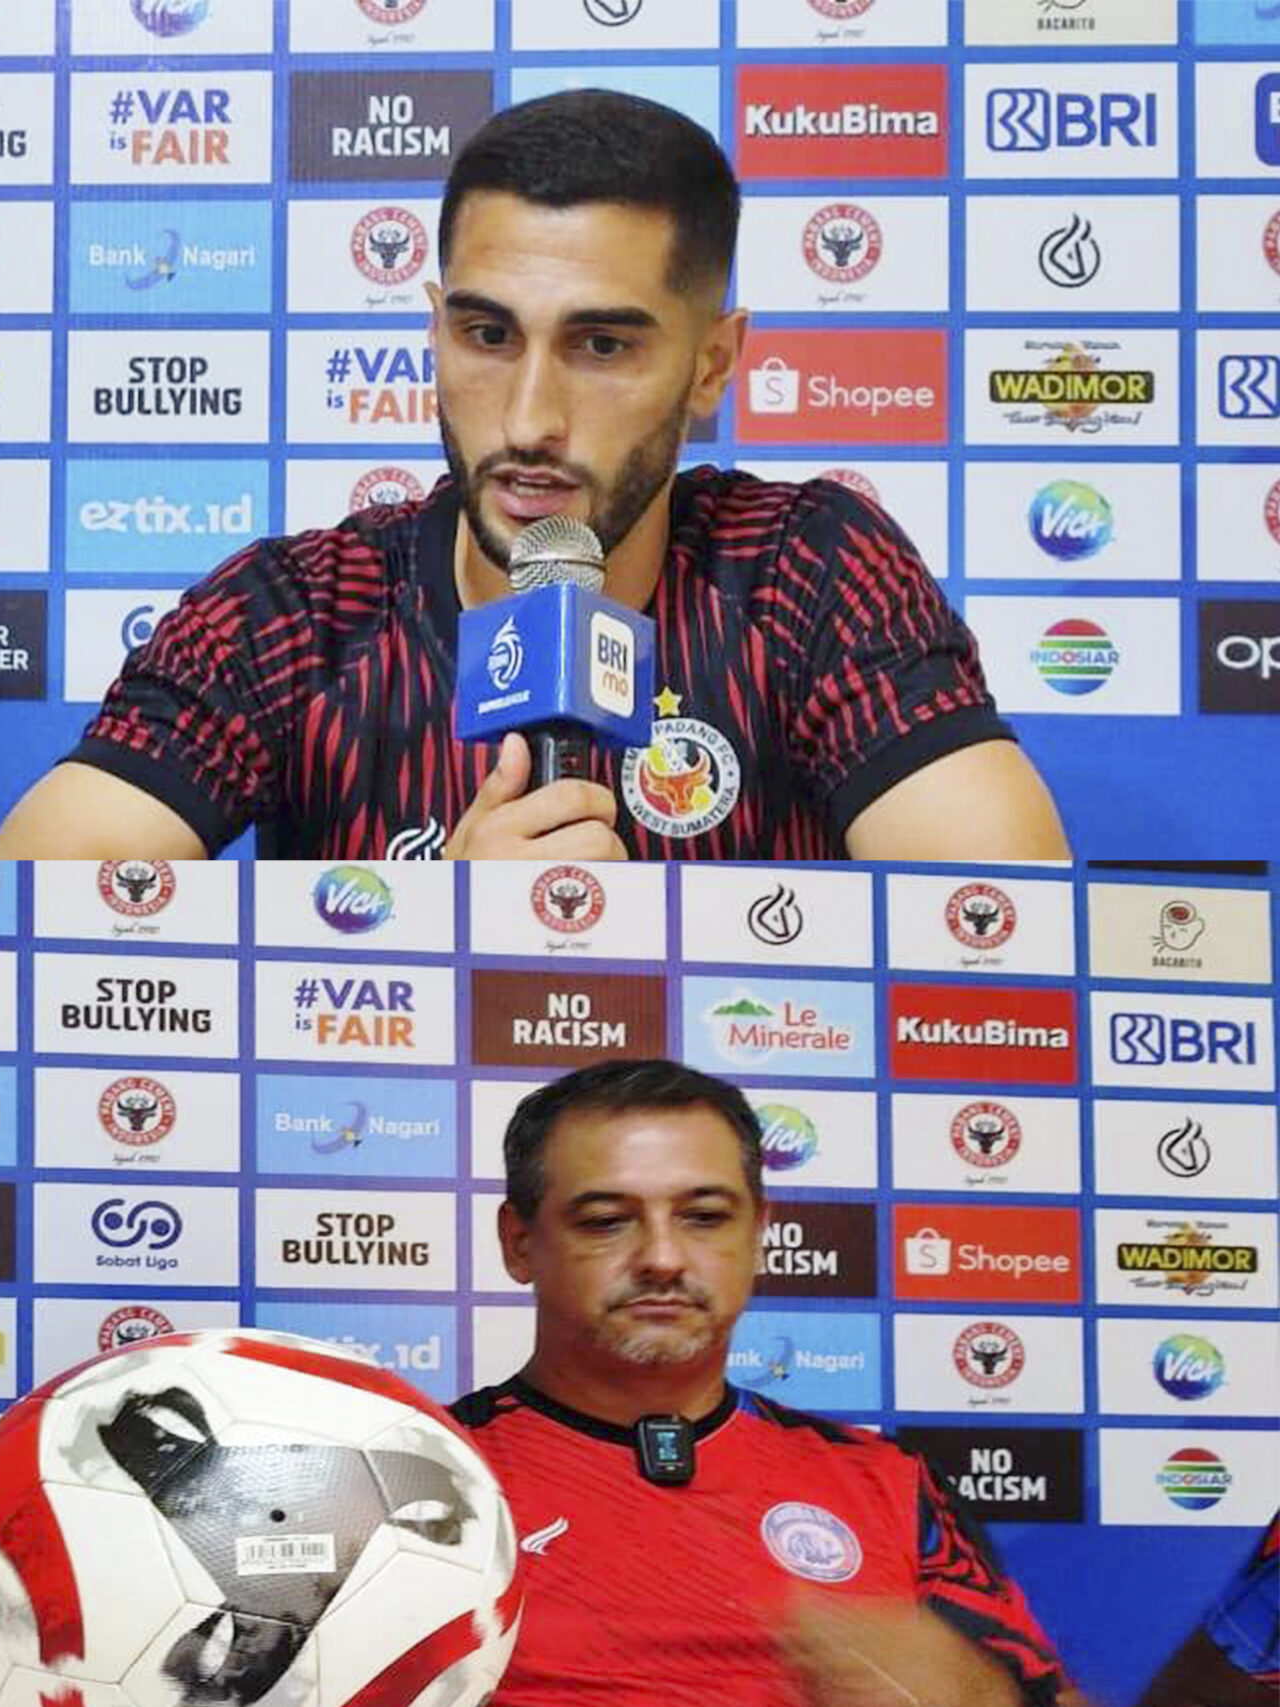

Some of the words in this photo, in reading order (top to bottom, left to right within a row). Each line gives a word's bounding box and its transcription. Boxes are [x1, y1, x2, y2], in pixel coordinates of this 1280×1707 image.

[110, 89, 231, 124] #VAR
[369, 96, 413, 125] NO
[744, 105, 938, 137] KukuBima
[1058, 94, 1156, 147] BRI
[110, 134, 126, 150] is
[132, 130, 230, 164] FAIR
[332, 127, 450, 156] RACISM
[89, 245, 145, 267] Bank
[184, 245, 255, 270] Nagari
[128, 357, 208, 383] STOP
[808, 377, 935, 415] Shopee
[995, 373, 1146, 401] WADIMOR
[95, 388, 242, 415] BULLYING
[327, 393, 344, 410] is
[597, 633, 628, 672] BRI
[1030, 649, 1120, 667] INDOSIAR
[623, 748, 640, 781] SEM
[96, 979, 177, 1004] STOP
[294, 979, 415, 1012] #VAR
[61, 1005, 211, 1034] BULLYING
[548, 993, 590, 1020] NO
[784, 1002, 817, 1027] Le
[296, 1014, 312, 1031] is
[317, 1013, 416, 1048] FAIR
[513, 1019, 626, 1048] RACISM
[728, 1023, 850, 1050] Minerale
[896, 1016, 1069, 1050] KukuBima
[1171, 1021, 1255, 1065] BRI
[274, 1113, 332, 1133] Bank
[369, 1116, 440, 1139] Nagari
[316, 1213, 395, 1238] STOP
[762, 1222, 803, 1248] NO
[96, 1255, 142, 1268] Sobat
[146, 1255, 179, 1270] Liga
[282, 1240, 430, 1267] BULLYING
[760, 1250, 837, 1275] CISM
[958, 1244, 1071, 1278] Shopee
[1121, 1245, 1251, 1271] WADIMOR
[796, 1351, 864, 1371] Nagari
[970, 1448, 1011, 1474] NO
[948, 1476, 1046, 1501] ACISM
